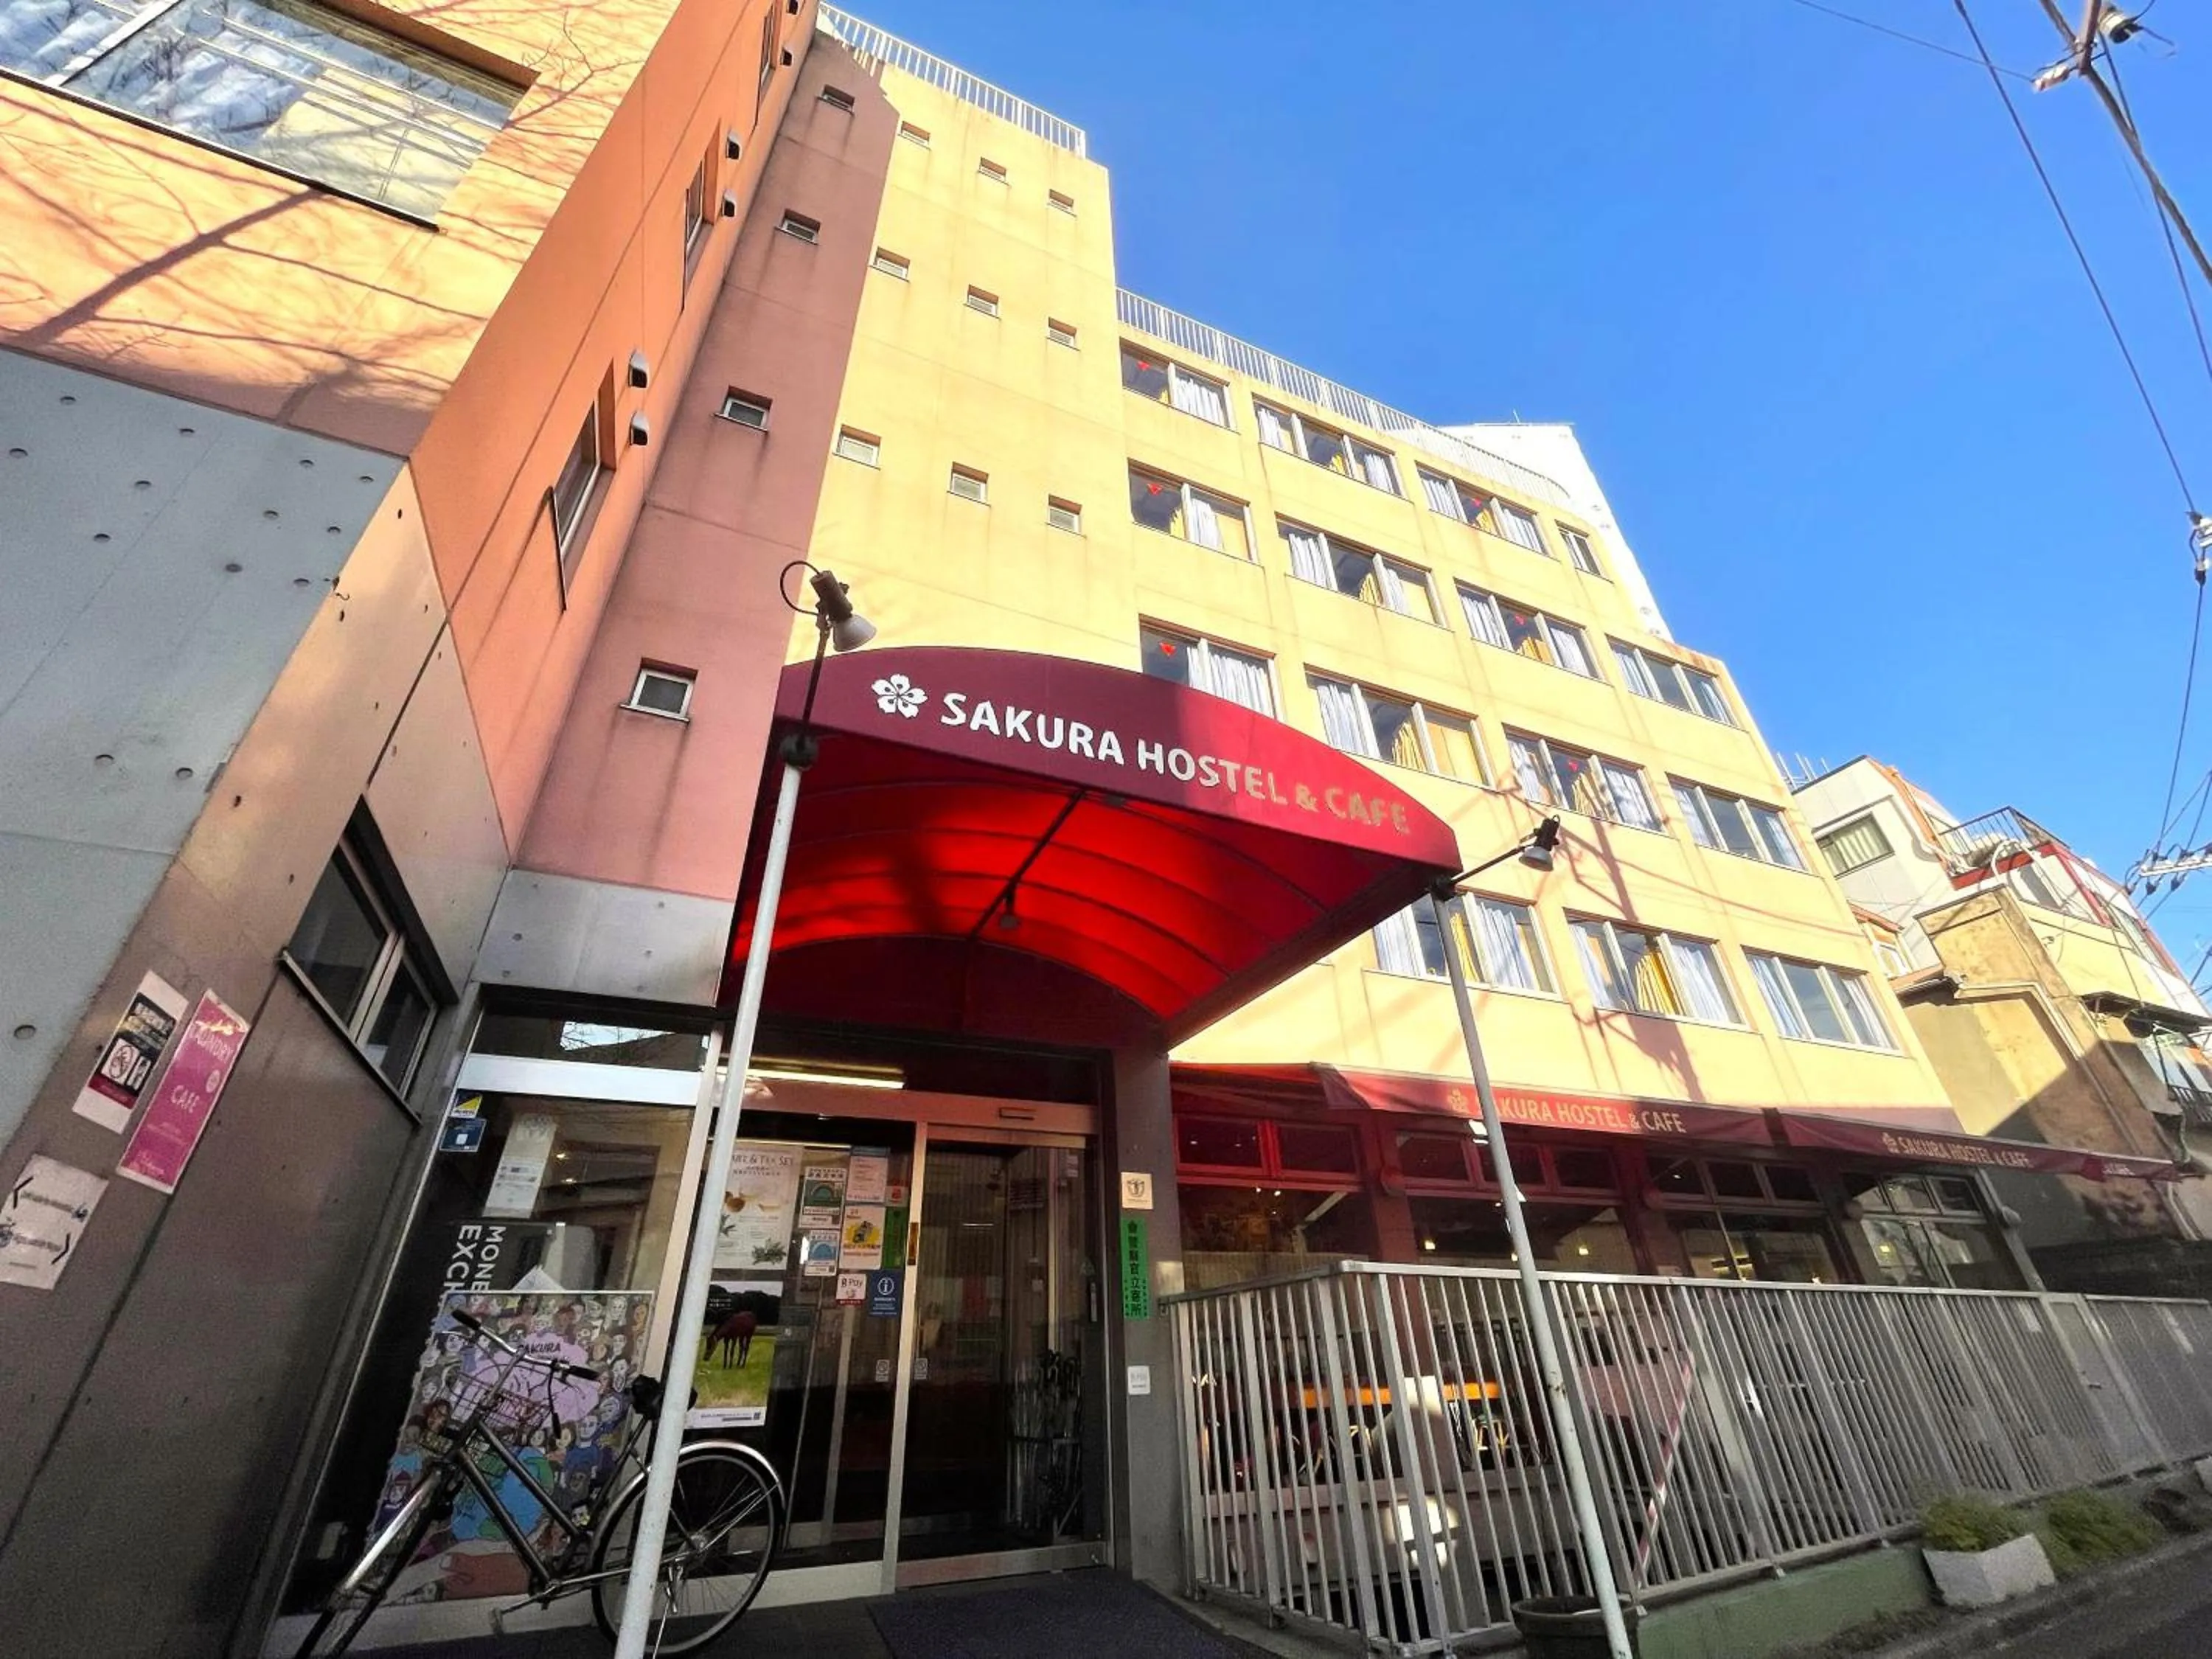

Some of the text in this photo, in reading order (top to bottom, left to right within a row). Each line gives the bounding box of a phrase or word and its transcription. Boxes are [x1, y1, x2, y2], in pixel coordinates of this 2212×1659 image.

[940, 692, 1410, 835] SAKURA HOSTEL & CAFE
[1475, 1096, 1687, 1133] KURA HOSTEL & CAFE
[1897, 1136, 1952, 1160] SAKURA
[1947, 1144, 1995, 1164] HOSTEL
[2001, 1151, 2034, 1169] CAFE
[443, 1225, 483, 1292] EXCH
[470, 1226, 507, 1292] MONE
